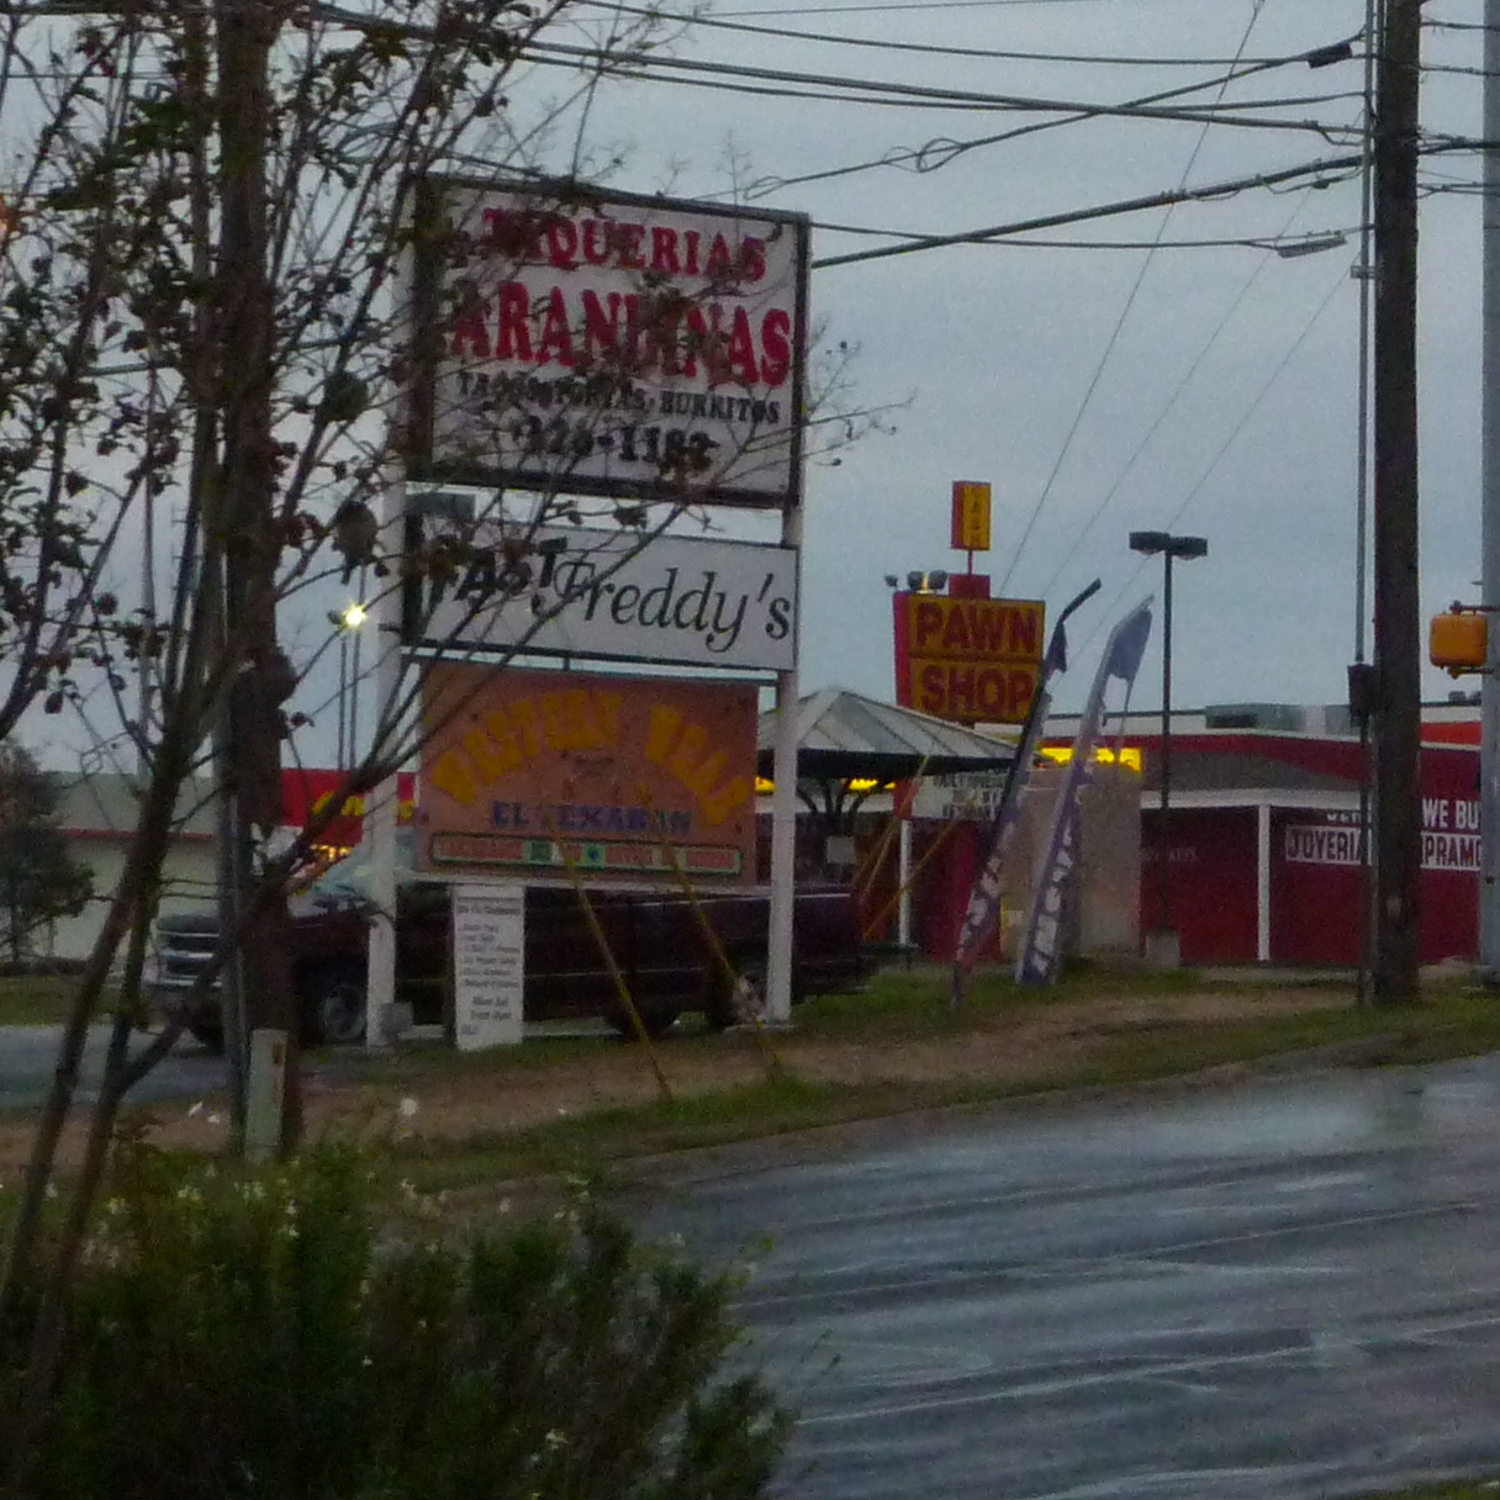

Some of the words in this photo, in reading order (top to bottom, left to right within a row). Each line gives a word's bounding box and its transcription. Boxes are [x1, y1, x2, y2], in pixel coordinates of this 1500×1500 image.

[484, 208, 767, 281] TQUERIAS
[532, 561, 791, 652] Freddy's
[916, 603, 1037, 652] PAWN
[921, 664, 1032, 716] SHOP
[1422, 797, 1448, 828] WE
[1455, 798, 1481, 830] BU
